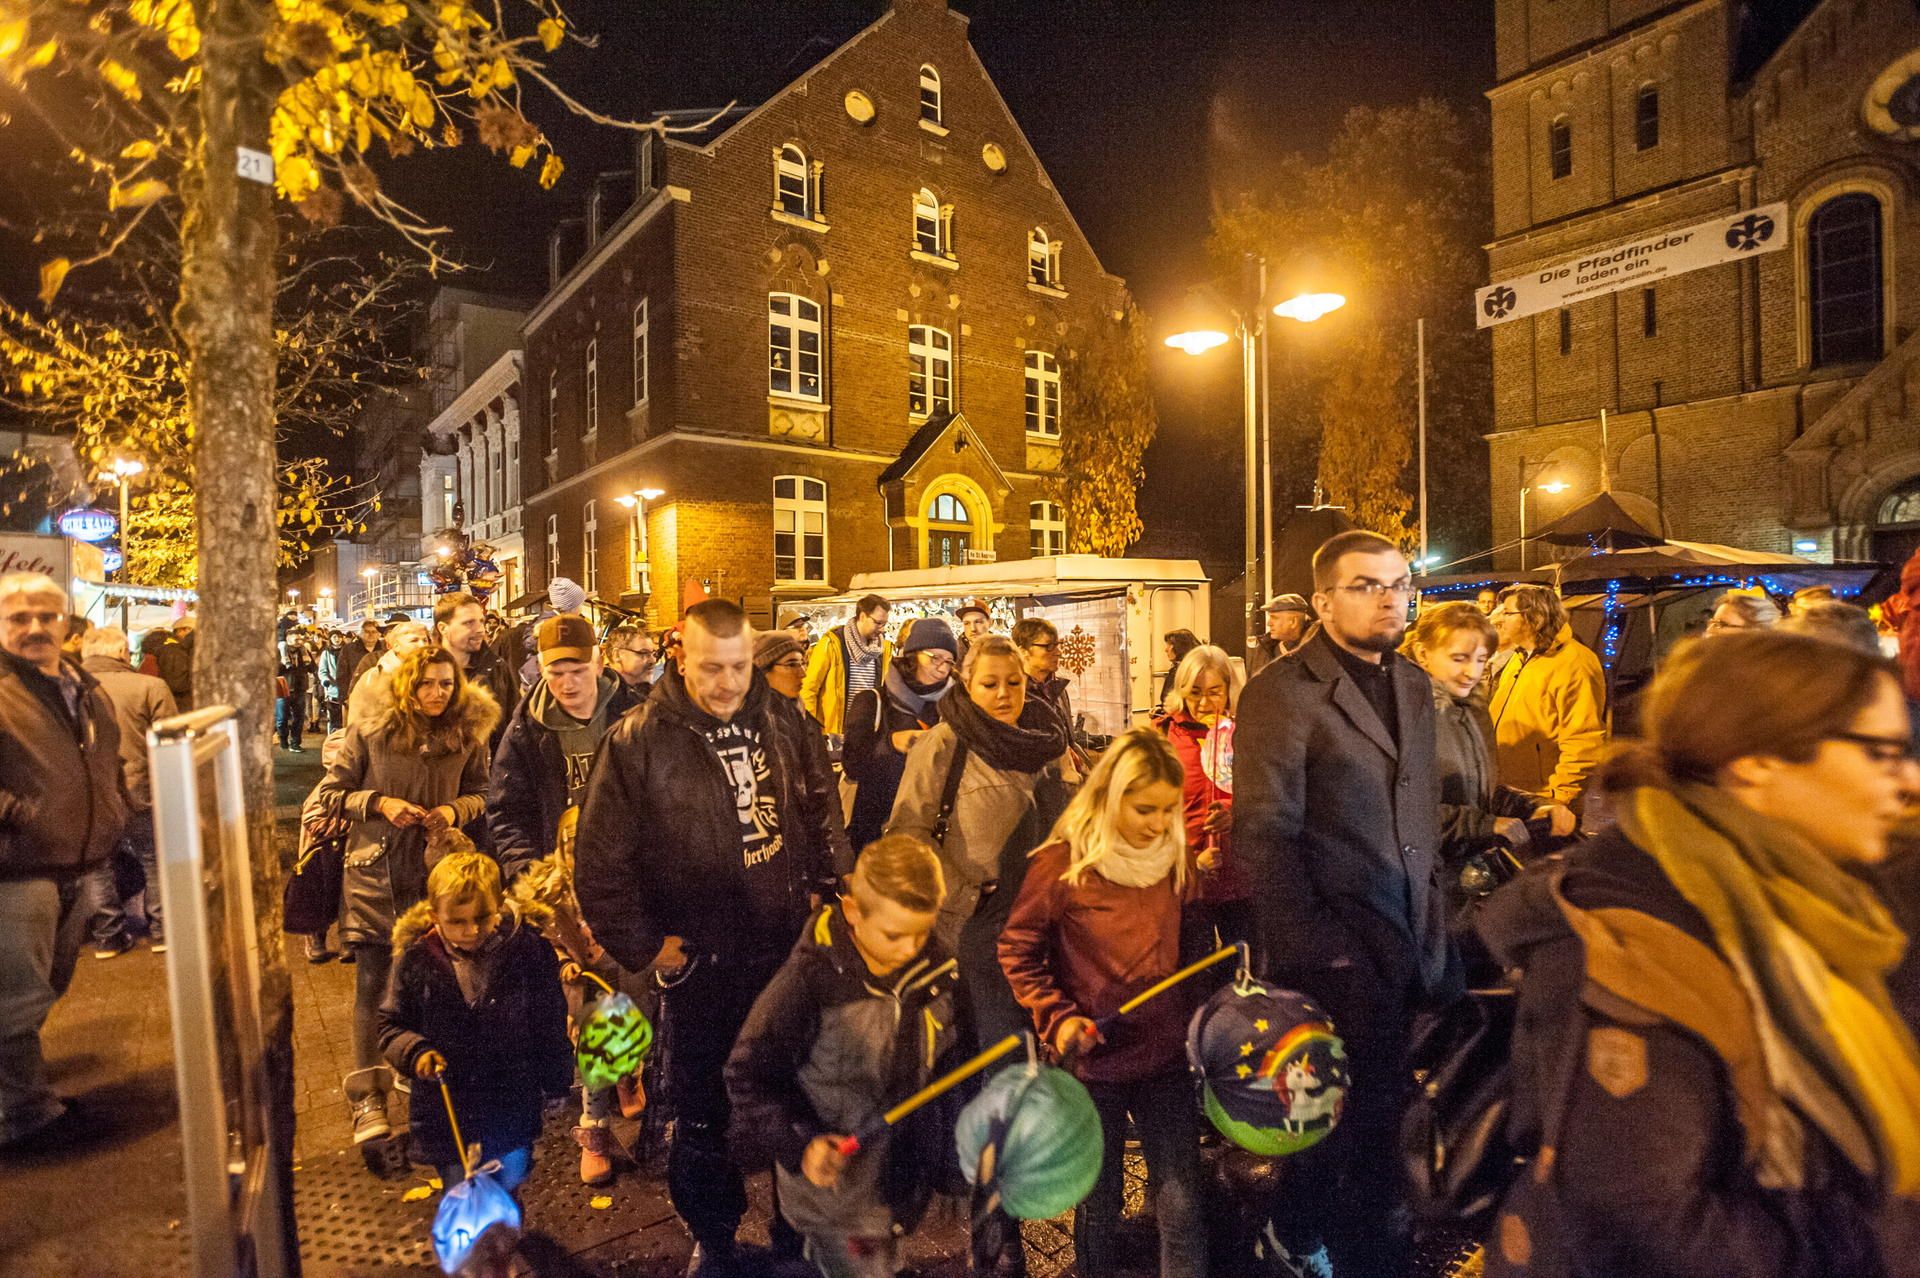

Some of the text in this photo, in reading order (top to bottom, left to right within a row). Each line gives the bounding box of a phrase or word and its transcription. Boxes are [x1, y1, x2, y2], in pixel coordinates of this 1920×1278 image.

[241, 155, 260, 173] 21
[1539, 232, 1695, 285] Die Pfadfinder
[1576, 258, 1650, 285] laden ein
